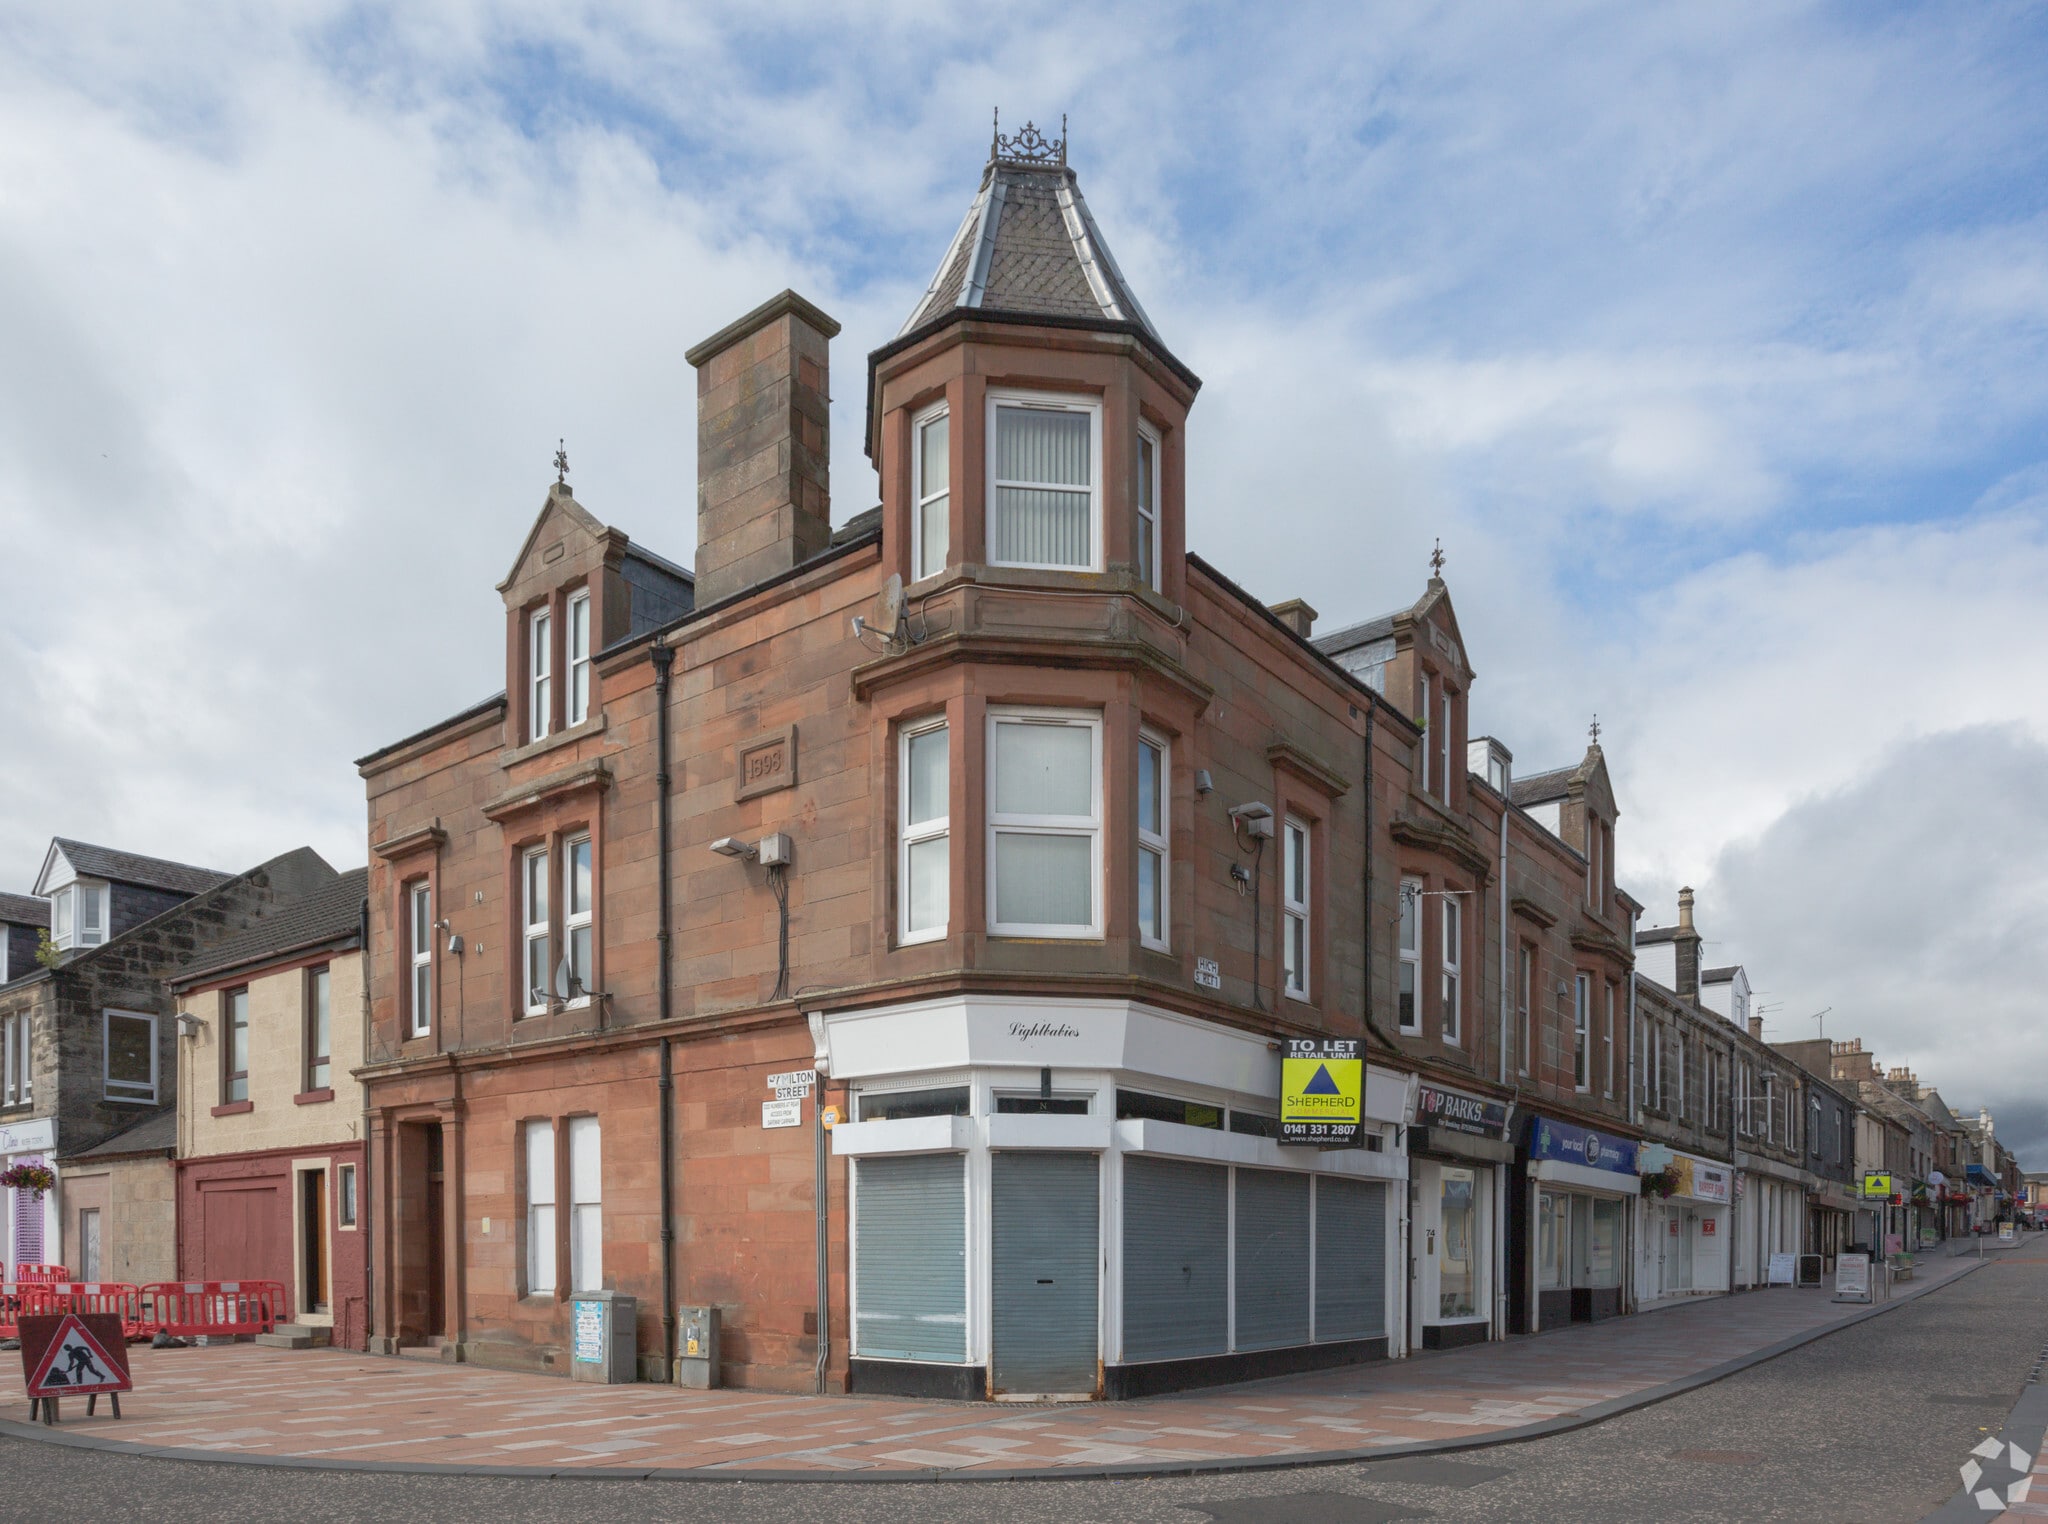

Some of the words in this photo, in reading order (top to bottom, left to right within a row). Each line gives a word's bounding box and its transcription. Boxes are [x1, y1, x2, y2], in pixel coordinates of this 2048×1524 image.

[1196, 970, 1218, 987] SREET
[1289, 1040, 1315, 1051] TO
[1323, 1041, 1358, 1052] LET
[777, 1085, 807, 1098] STREET
[1287, 1095, 1355, 1107] SHEPHERD
[1445, 1095, 1483, 1122] BARKS
[1284, 1124, 1306, 1134] 0141
[1310, 1124, 1328, 1134] 331
[1331, 1125, 1356, 1135] 2807
[1426, 1229, 1435, 1237] 74
